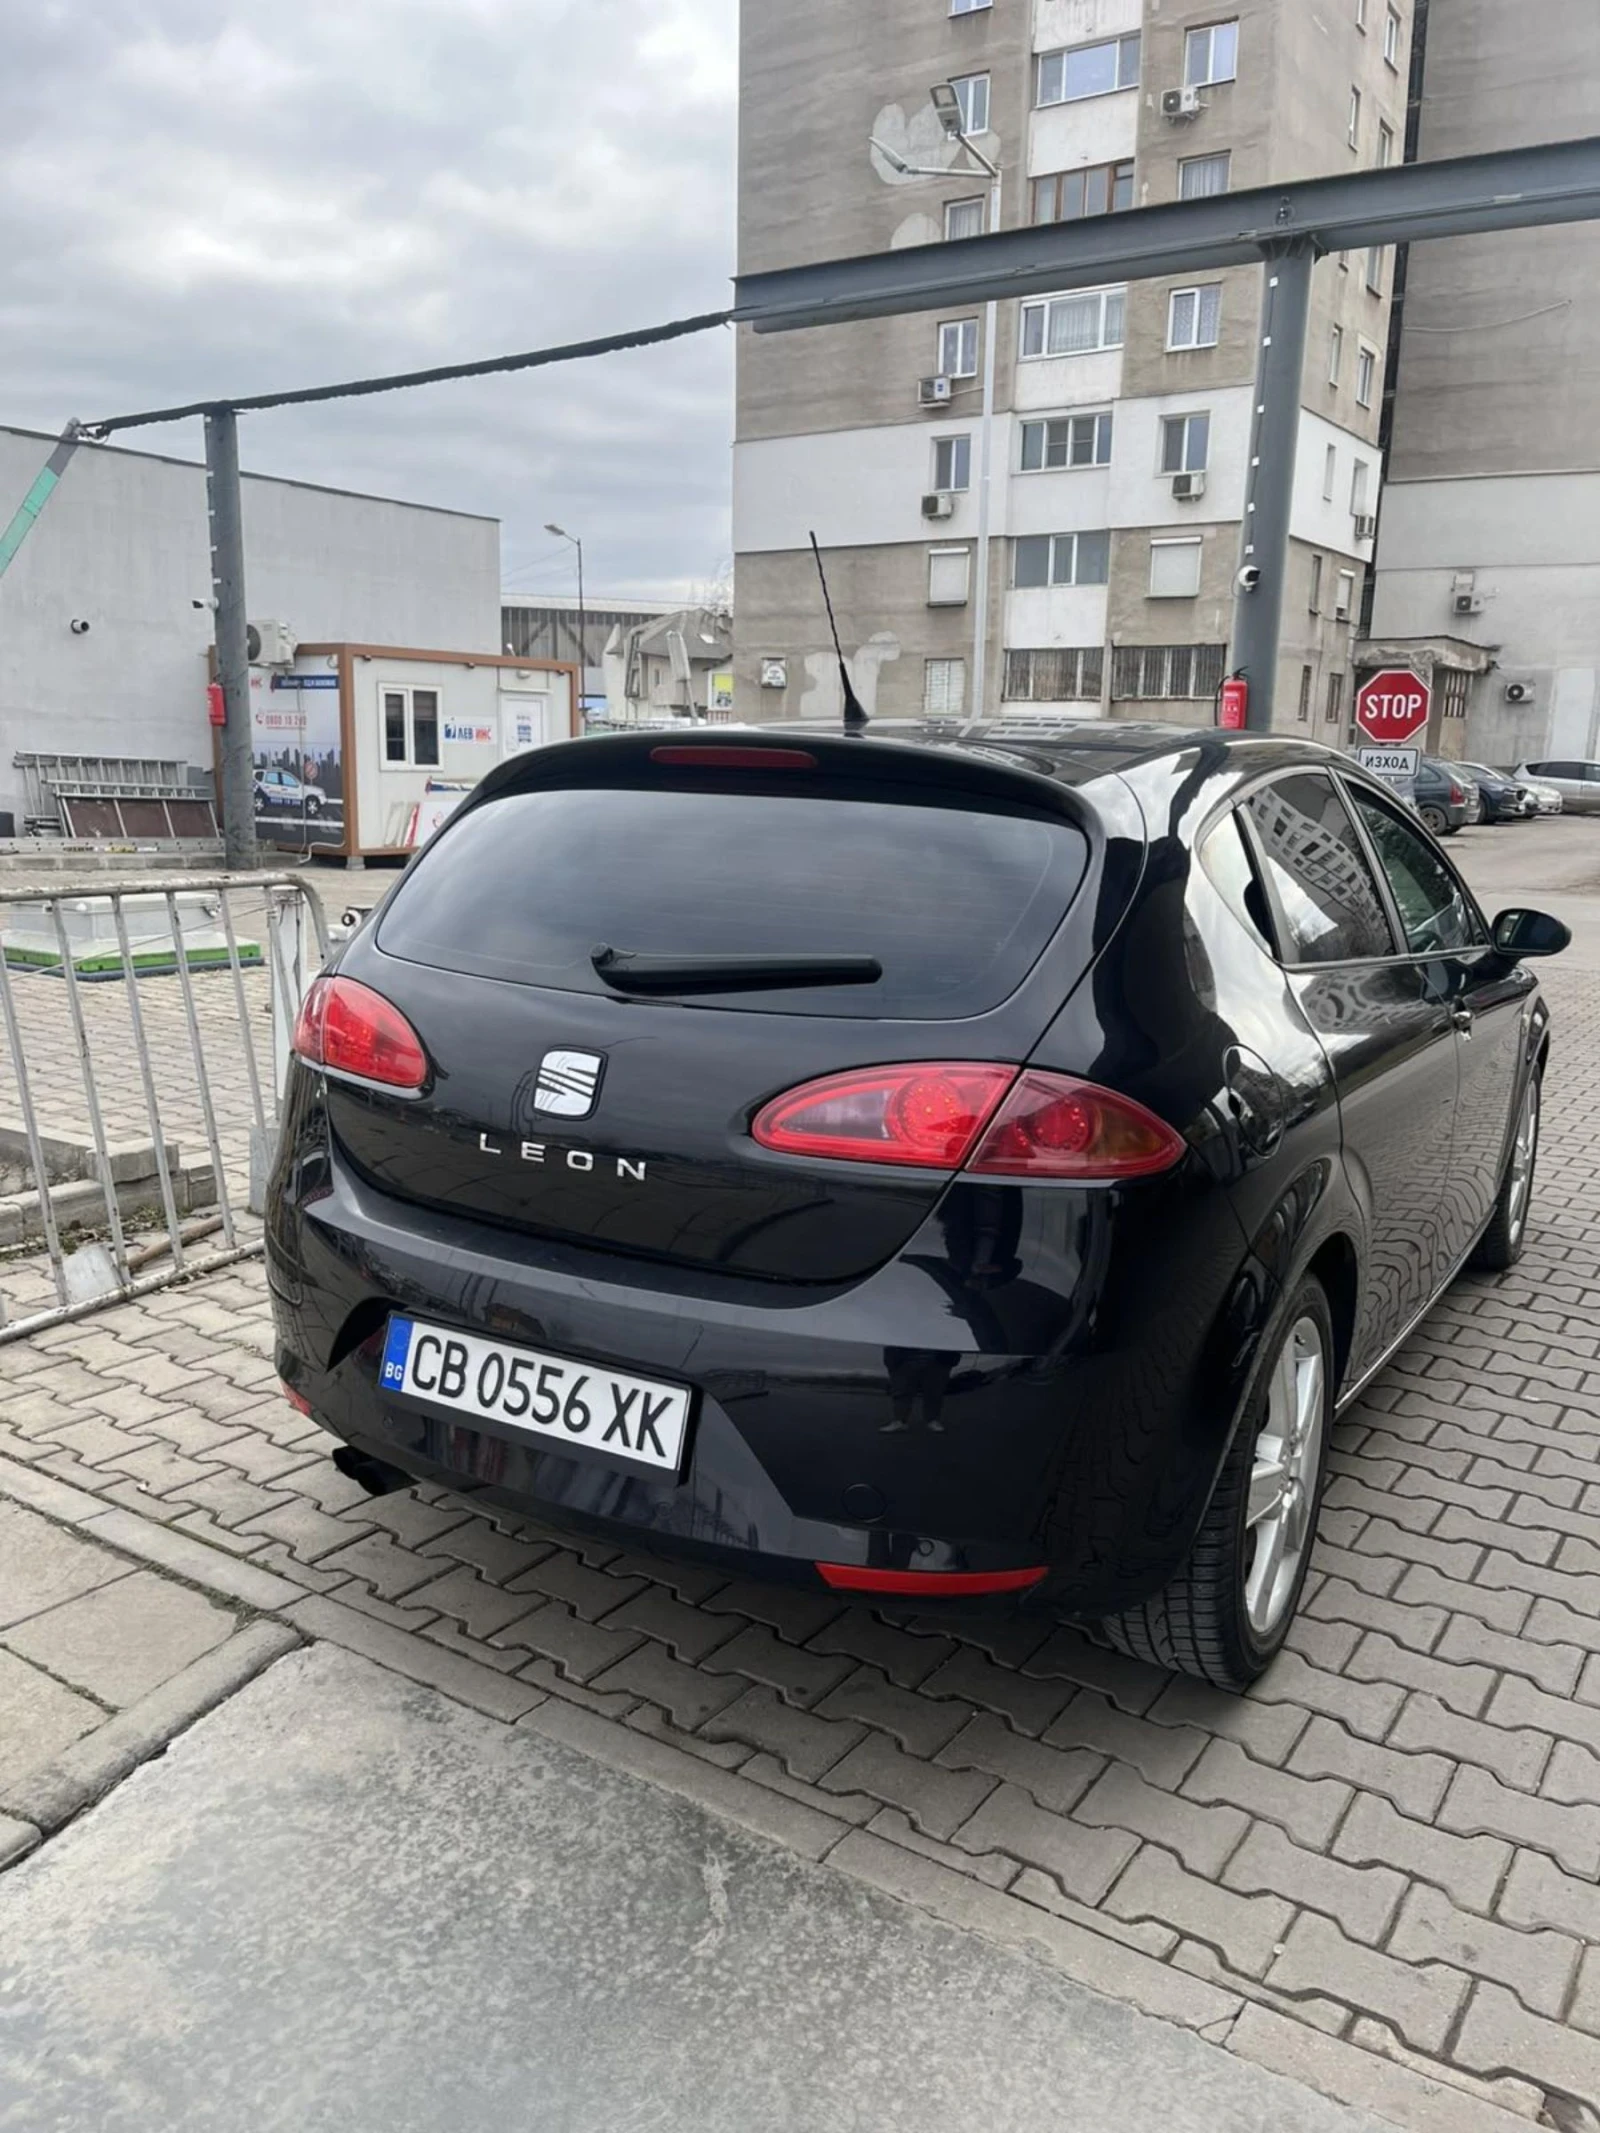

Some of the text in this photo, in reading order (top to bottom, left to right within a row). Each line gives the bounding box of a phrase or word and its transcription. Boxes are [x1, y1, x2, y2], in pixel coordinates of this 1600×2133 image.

[1365, 694, 1422, 719] STOP
[457, 727, 492, 741] ЛЕВ ИНС
[1365, 755, 1409, 770] ИЗХОД
[479, 1133, 646, 1181] LEON
[384, 1361, 403, 1381] BG
[411, 1335, 674, 1458] CB 0556 XK
